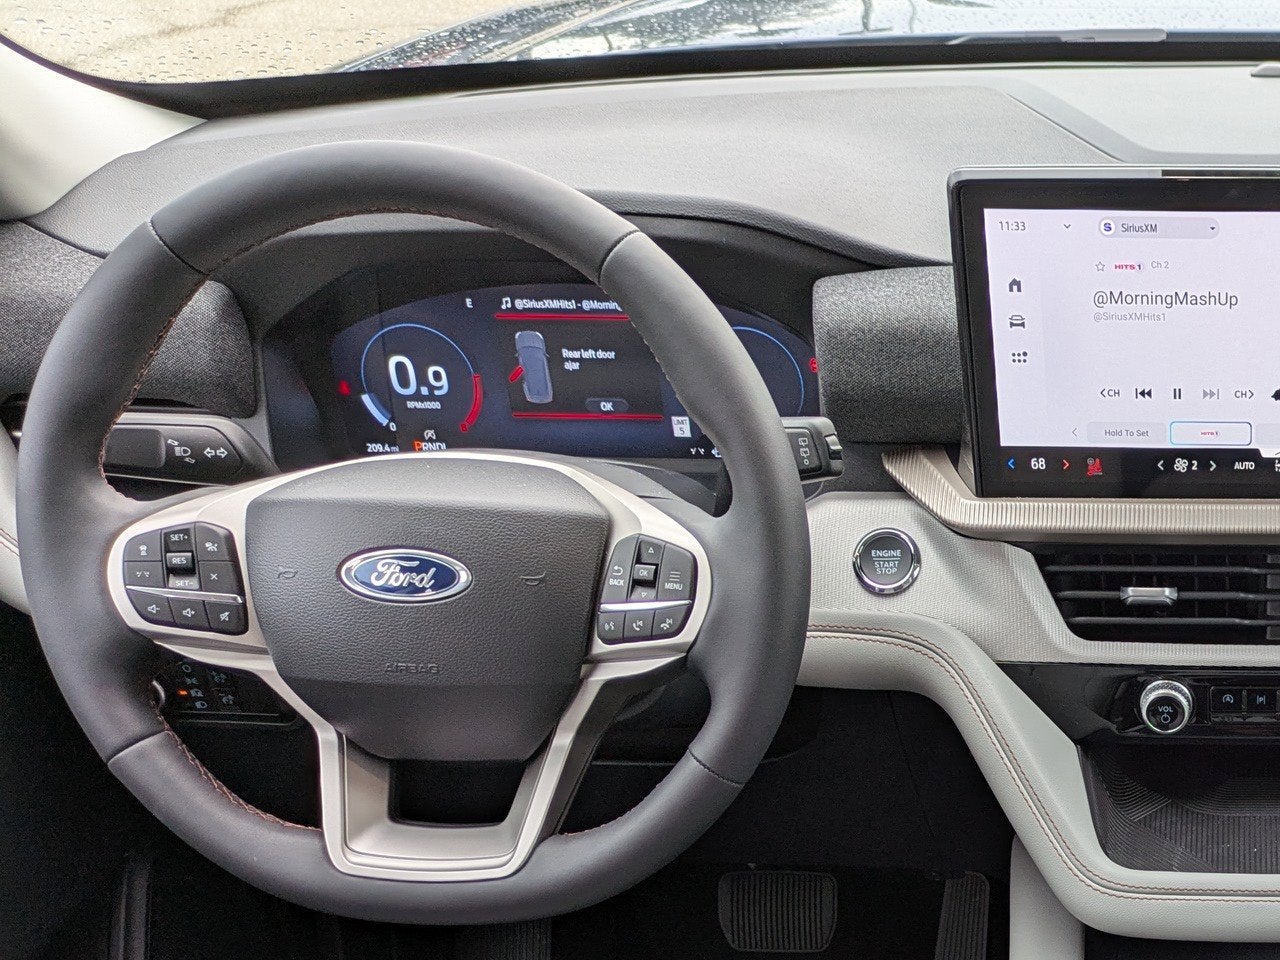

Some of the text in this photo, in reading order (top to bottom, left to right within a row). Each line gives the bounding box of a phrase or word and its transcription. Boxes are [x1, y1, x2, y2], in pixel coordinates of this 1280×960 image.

[998, 220, 1027, 232] 11:33
[1120, 223, 1158, 234] SiriusXM
[1114, 263, 1136, 271] HITS
[1150, 260, 1169, 270] Ch 2
[1093, 290, 1239, 309] @MorningMashUp
[514, 299, 576, 311] @SiriusXMHits1
[1093, 312, 1166, 322] @SiriusXMHits1
[561, 348, 616, 360] Rear left door
[564, 361, 580, 371] ajar
[387, 355, 449, 396] 0.9
[600, 402, 614, 412] OK
[389, 423, 397, 432] 0
[679, 427, 685, 435] 5
[1104, 429, 1149, 438] Hold To Set
[366, 443, 391, 453] 209.4
[1030, 457, 1046, 470] 68
[1191, 460, 1198, 470] 2
[1234, 461, 1255, 470] AUTO
[169, 533, 188, 541] SET+
[871, 549, 902, 557] ENGINE
[172, 557, 187, 565] RES
[370, 558, 437, 589] Ford
[639, 569, 649, 577] OK
[876, 567, 898, 575] STOP
[608, 578, 625, 587] BACK
[664, 582, 683, 591] MENU
[384, 662, 440, 674] AIRBAG
[1157, 705, 1174, 713] VOL
